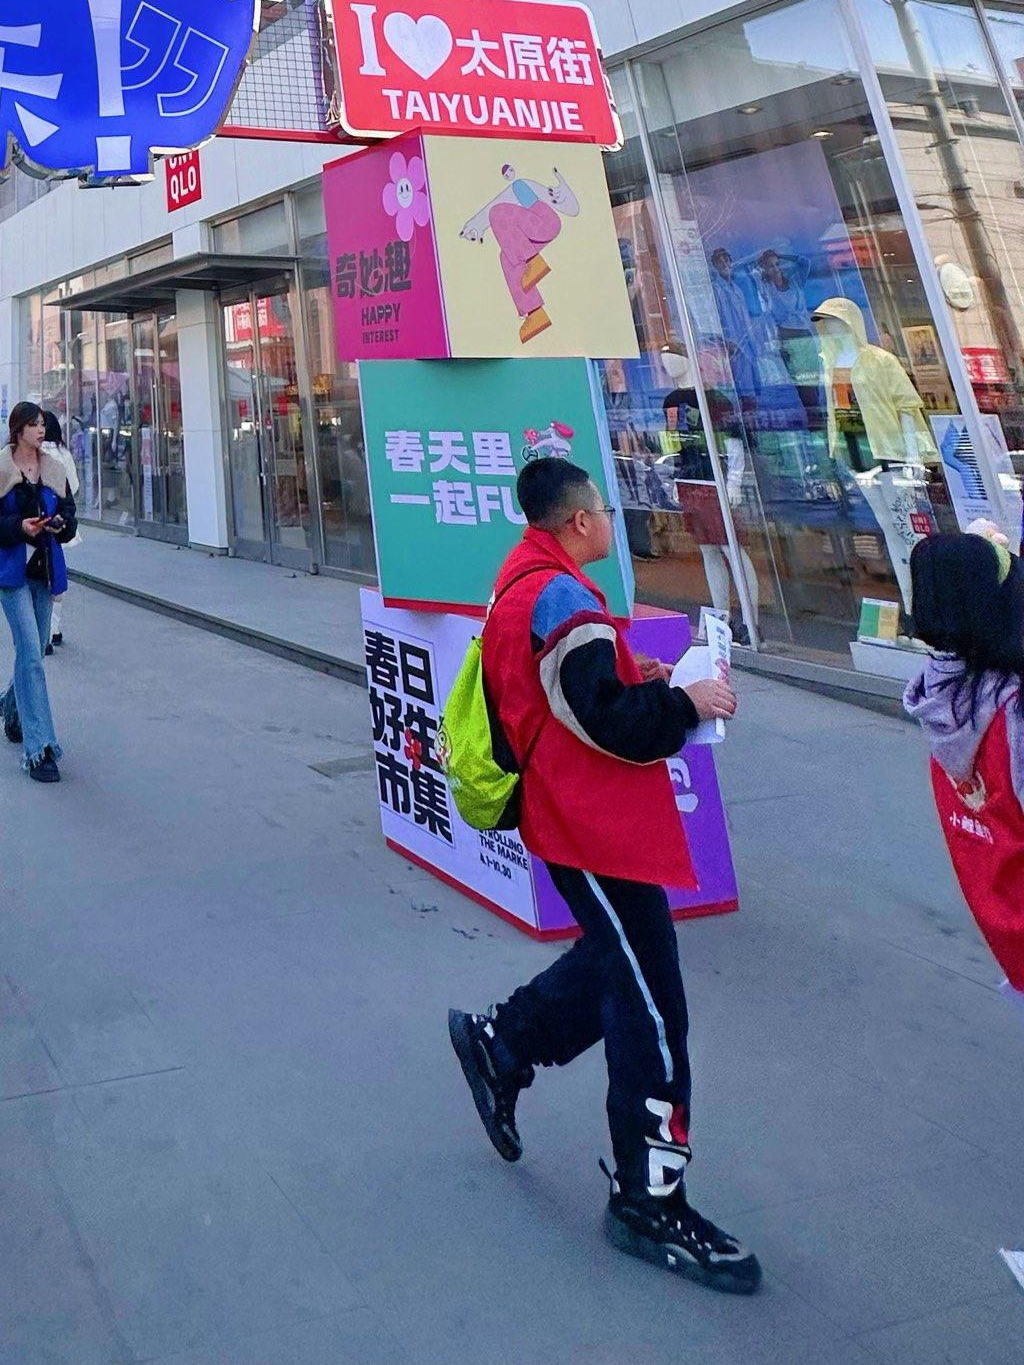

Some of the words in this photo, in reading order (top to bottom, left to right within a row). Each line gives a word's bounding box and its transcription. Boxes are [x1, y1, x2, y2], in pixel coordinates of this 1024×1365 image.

[350, 3, 387, 77] I
[456, 30, 595, 87] 太原街
[381, 88, 585, 135] TAIYUANJIE
[170, 165, 197, 204] QLO
[336, 241, 412, 299] 奇妙趣
[361, 303, 401, 326] HAPPY
[362, 329, 400, 344] INTEREST
[384, 430, 517, 476] 春天里
[390, 480, 528, 525] 一起FU
[364, 629, 434, 706] 春日
[369, 685, 444, 774] 好生
[375, 750, 453, 844] 市集
[479, 834, 496, 853] THE
